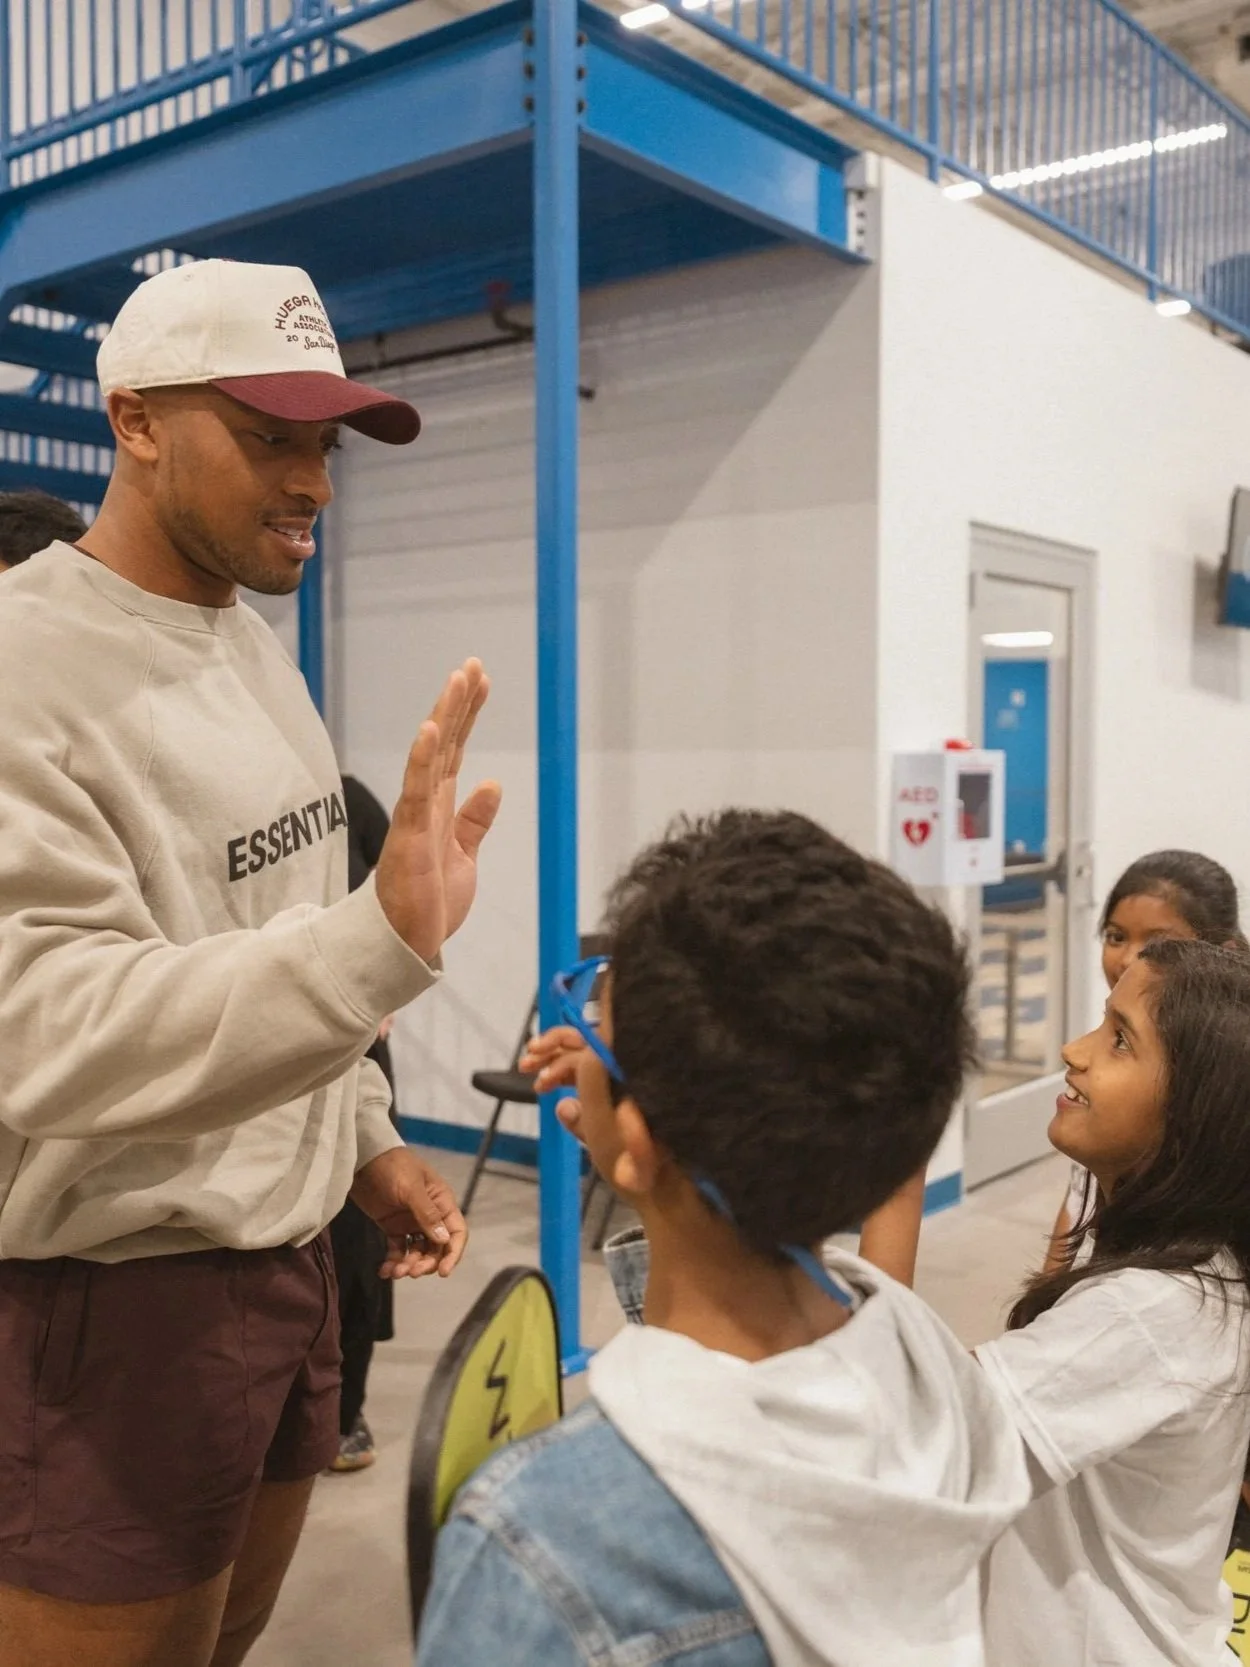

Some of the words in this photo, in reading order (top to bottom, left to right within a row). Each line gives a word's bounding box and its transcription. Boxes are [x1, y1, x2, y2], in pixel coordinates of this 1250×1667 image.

[286, 335, 299, 343] 20
[304, 336, 320, 350] San
[899, 786, 939, 803] AED
[227, 791, 349, 882] ESSENTIA
